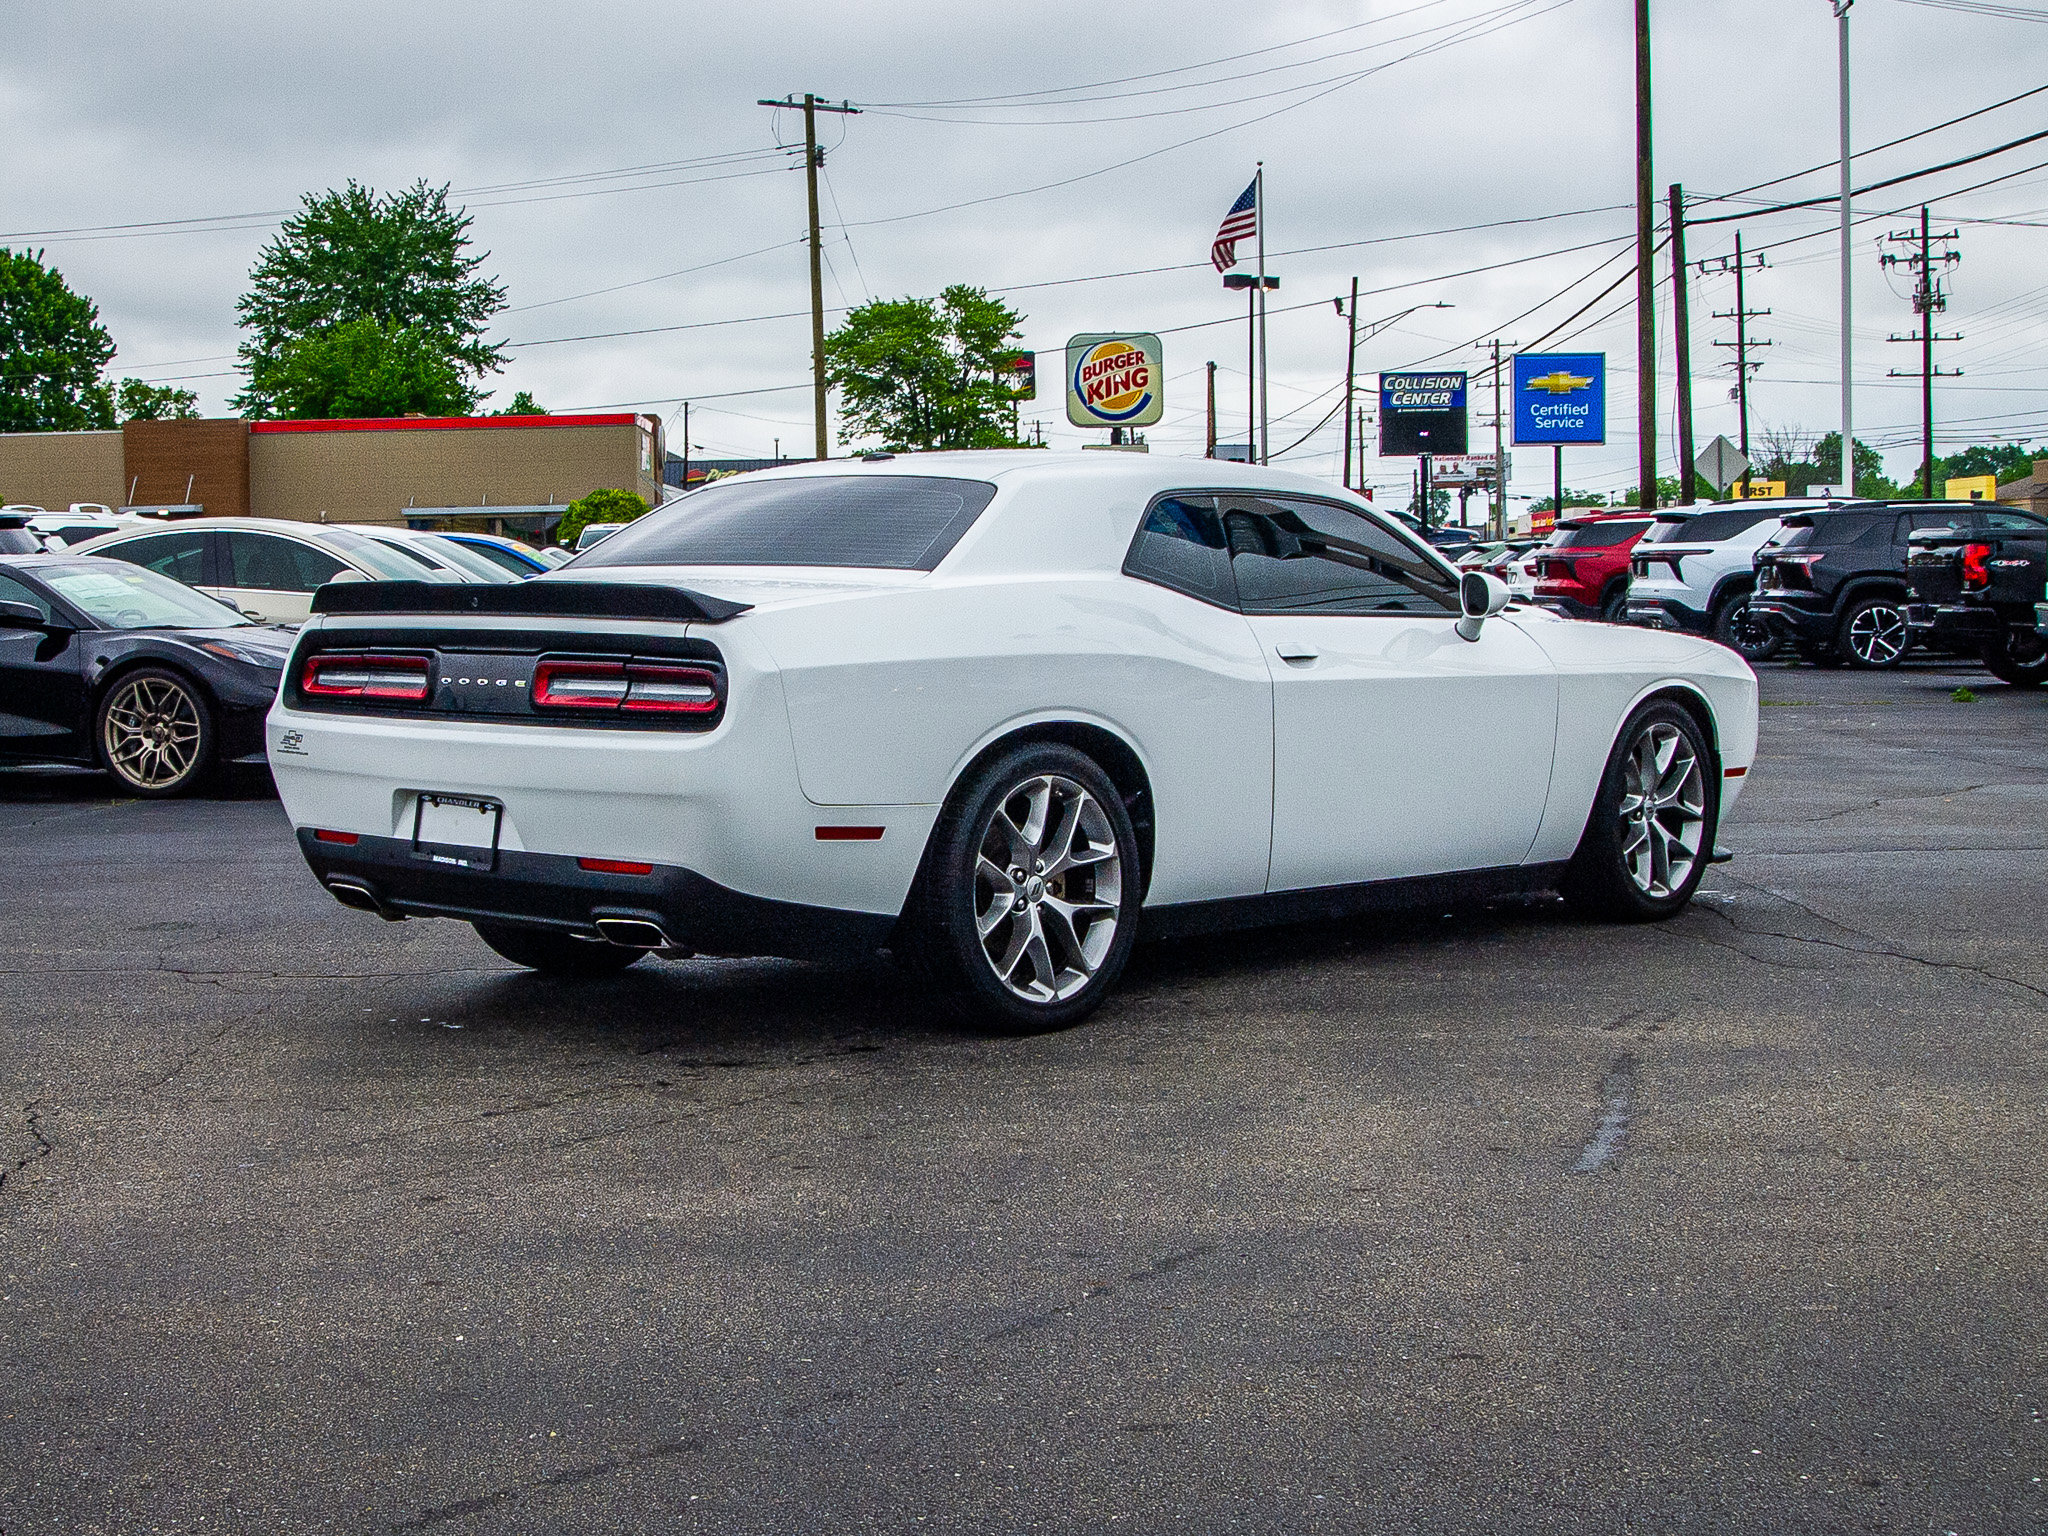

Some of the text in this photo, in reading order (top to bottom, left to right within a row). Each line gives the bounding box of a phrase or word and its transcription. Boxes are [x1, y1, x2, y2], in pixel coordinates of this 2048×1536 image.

[1082, 350, 1146, 383] BURGER
[1087, 367, 1149, 405] KING
[1383, 376, 1463, 390] COLLISION
[1391, 391, 1452, 405] CENTER
[1530, 403, 1589, 416] Certified
[1535, 416, 1584, 428] Service
[1739, 486, 1773, 497] RST
[441, 677, 527, 688] DODGE
[437, 796, 480, 809] CHANDLER
